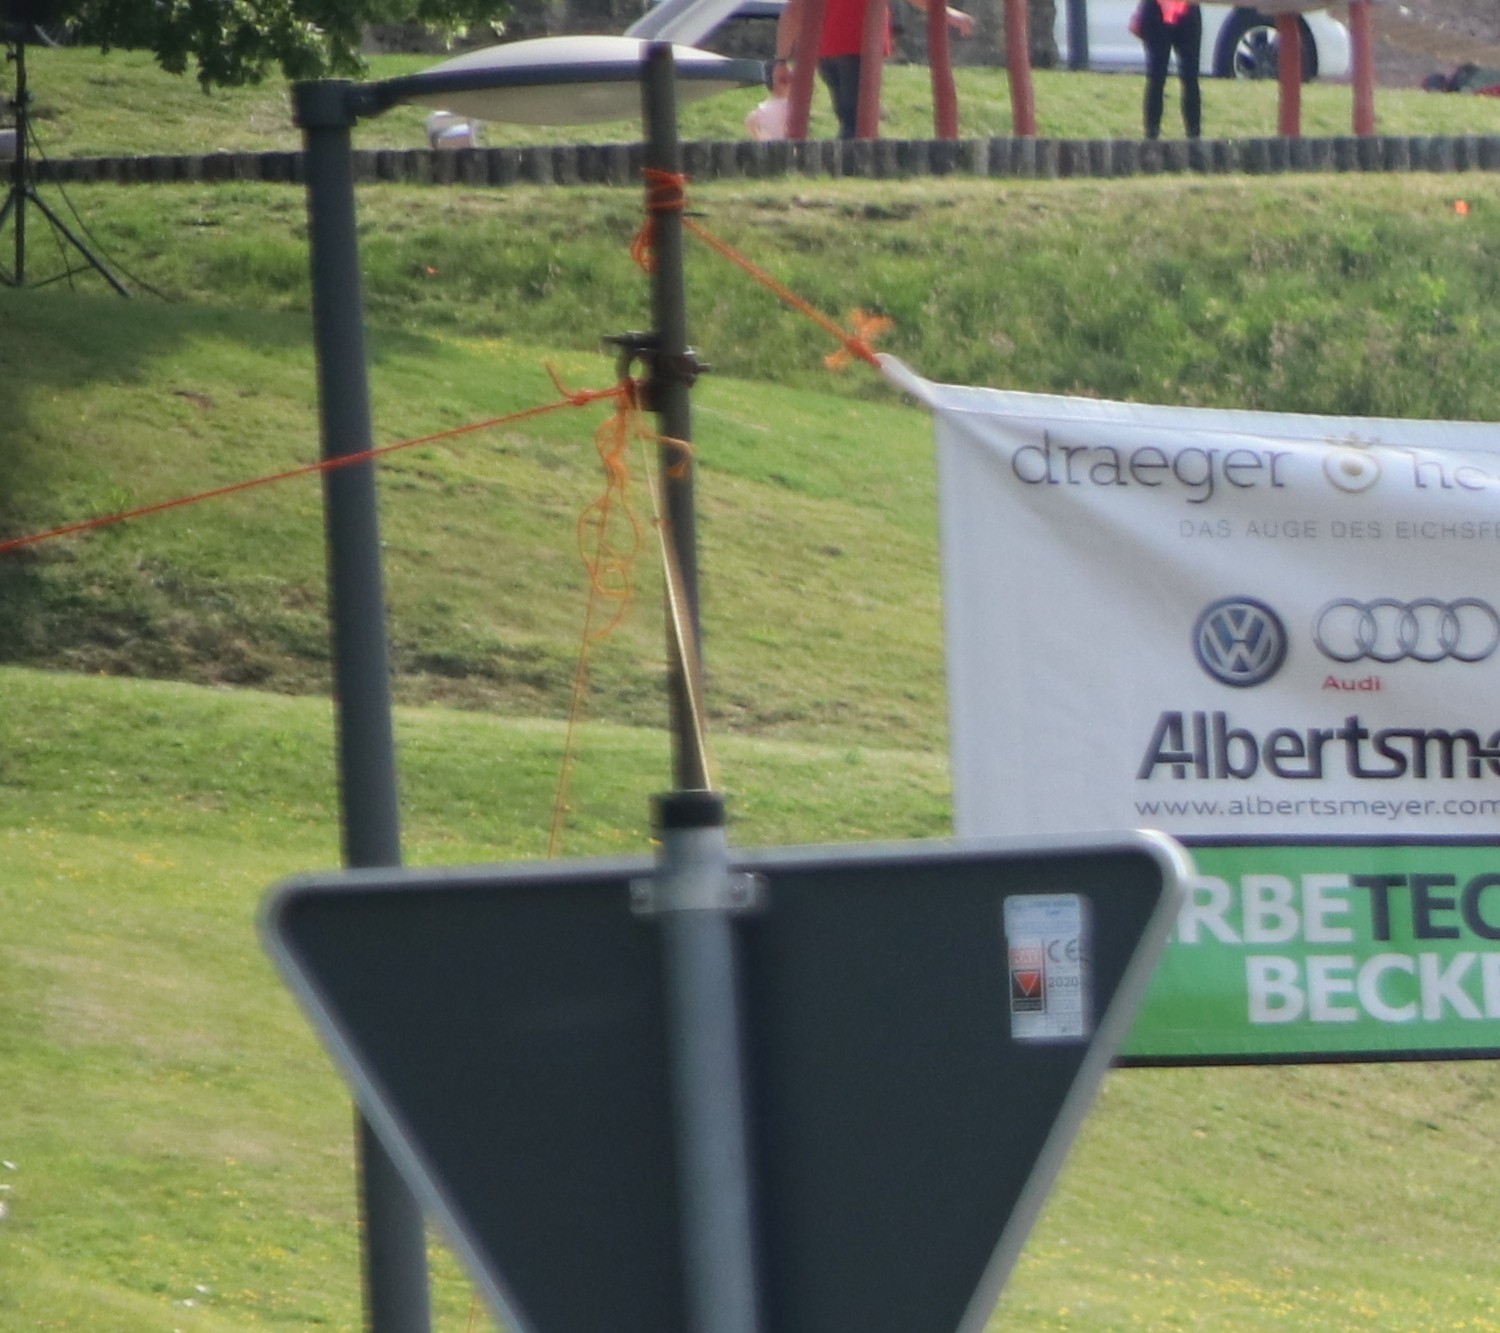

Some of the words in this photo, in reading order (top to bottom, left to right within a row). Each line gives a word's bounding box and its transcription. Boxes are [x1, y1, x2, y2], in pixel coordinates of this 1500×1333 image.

[1010, 429, 1296, 504] draeger
[1179, 519, 1232, 540] DAS
[1245, 519, 1318, 540] AUGE
[1331, 520, 1382, 540] DES
[1322, 675, 1382, 692] Audi
